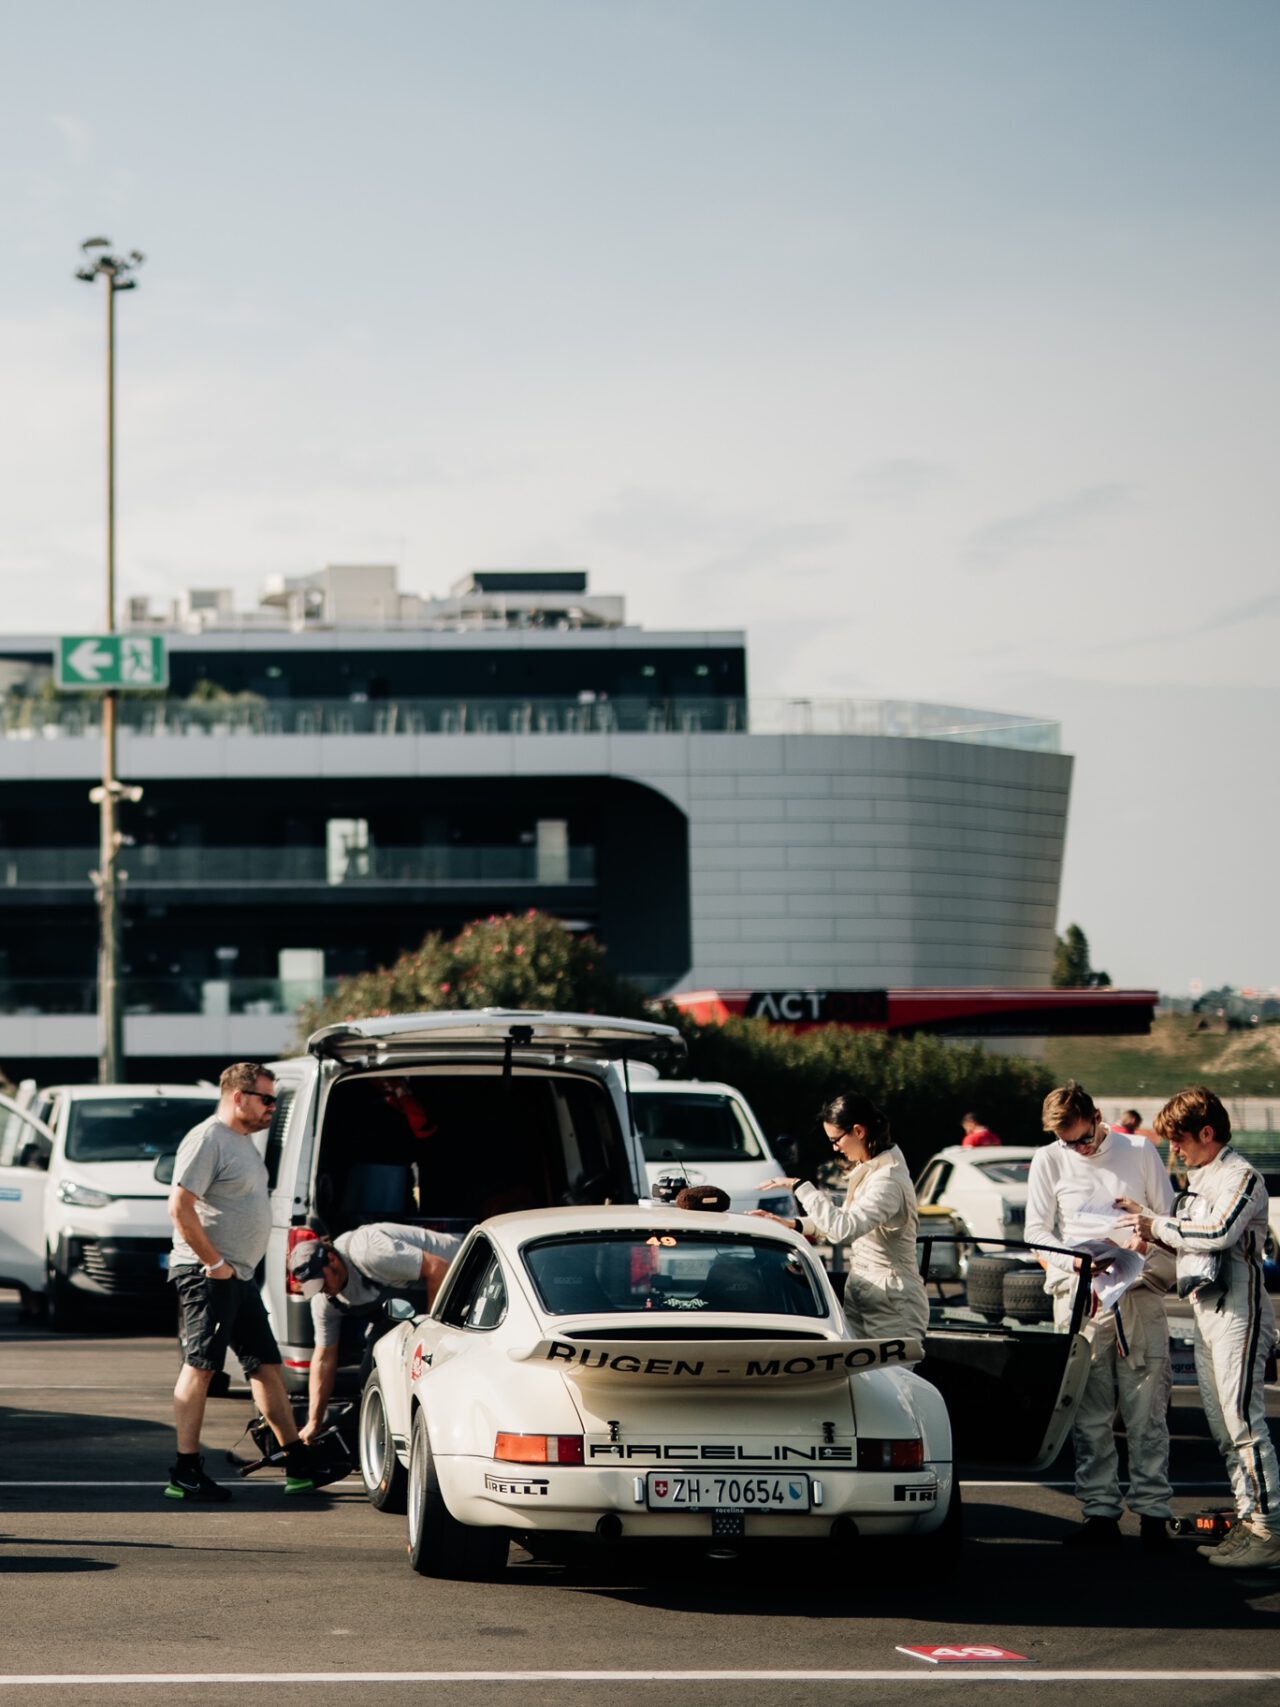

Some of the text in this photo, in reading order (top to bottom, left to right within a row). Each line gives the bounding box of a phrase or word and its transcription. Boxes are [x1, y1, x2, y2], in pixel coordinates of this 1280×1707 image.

[645, 1236, 678, 1247] 49
[546, 1341, 704, 1375] RUGEN
[746, 1338, 908, 1376] MOTOR
[590, 1444, 853, 1461] RACELINE
[484, 1472, 550, 1496] PIRELLI
[931, 1647, 1004, 1657] 49
